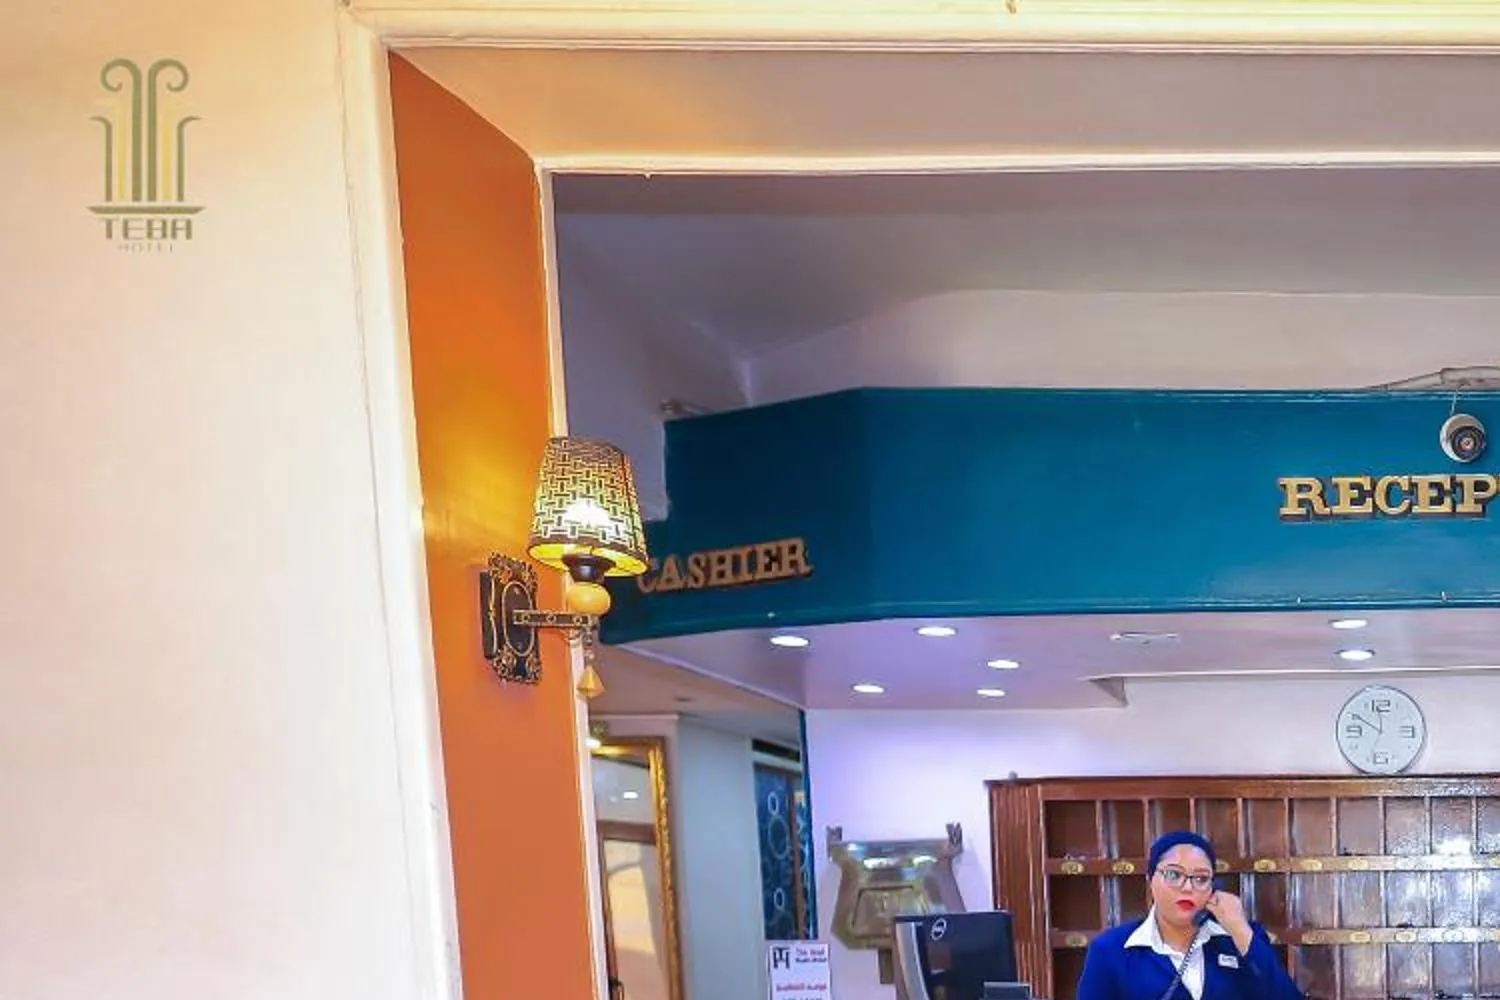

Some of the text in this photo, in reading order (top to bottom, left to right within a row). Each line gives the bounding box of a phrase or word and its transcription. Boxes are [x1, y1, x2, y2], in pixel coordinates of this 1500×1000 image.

[1371, 699, 1391, 713] 12
[1345, 725, 1363, 739] 9
[1399, 725, 1415, 739] 3
[1373, 751, 1389, 765] 6
